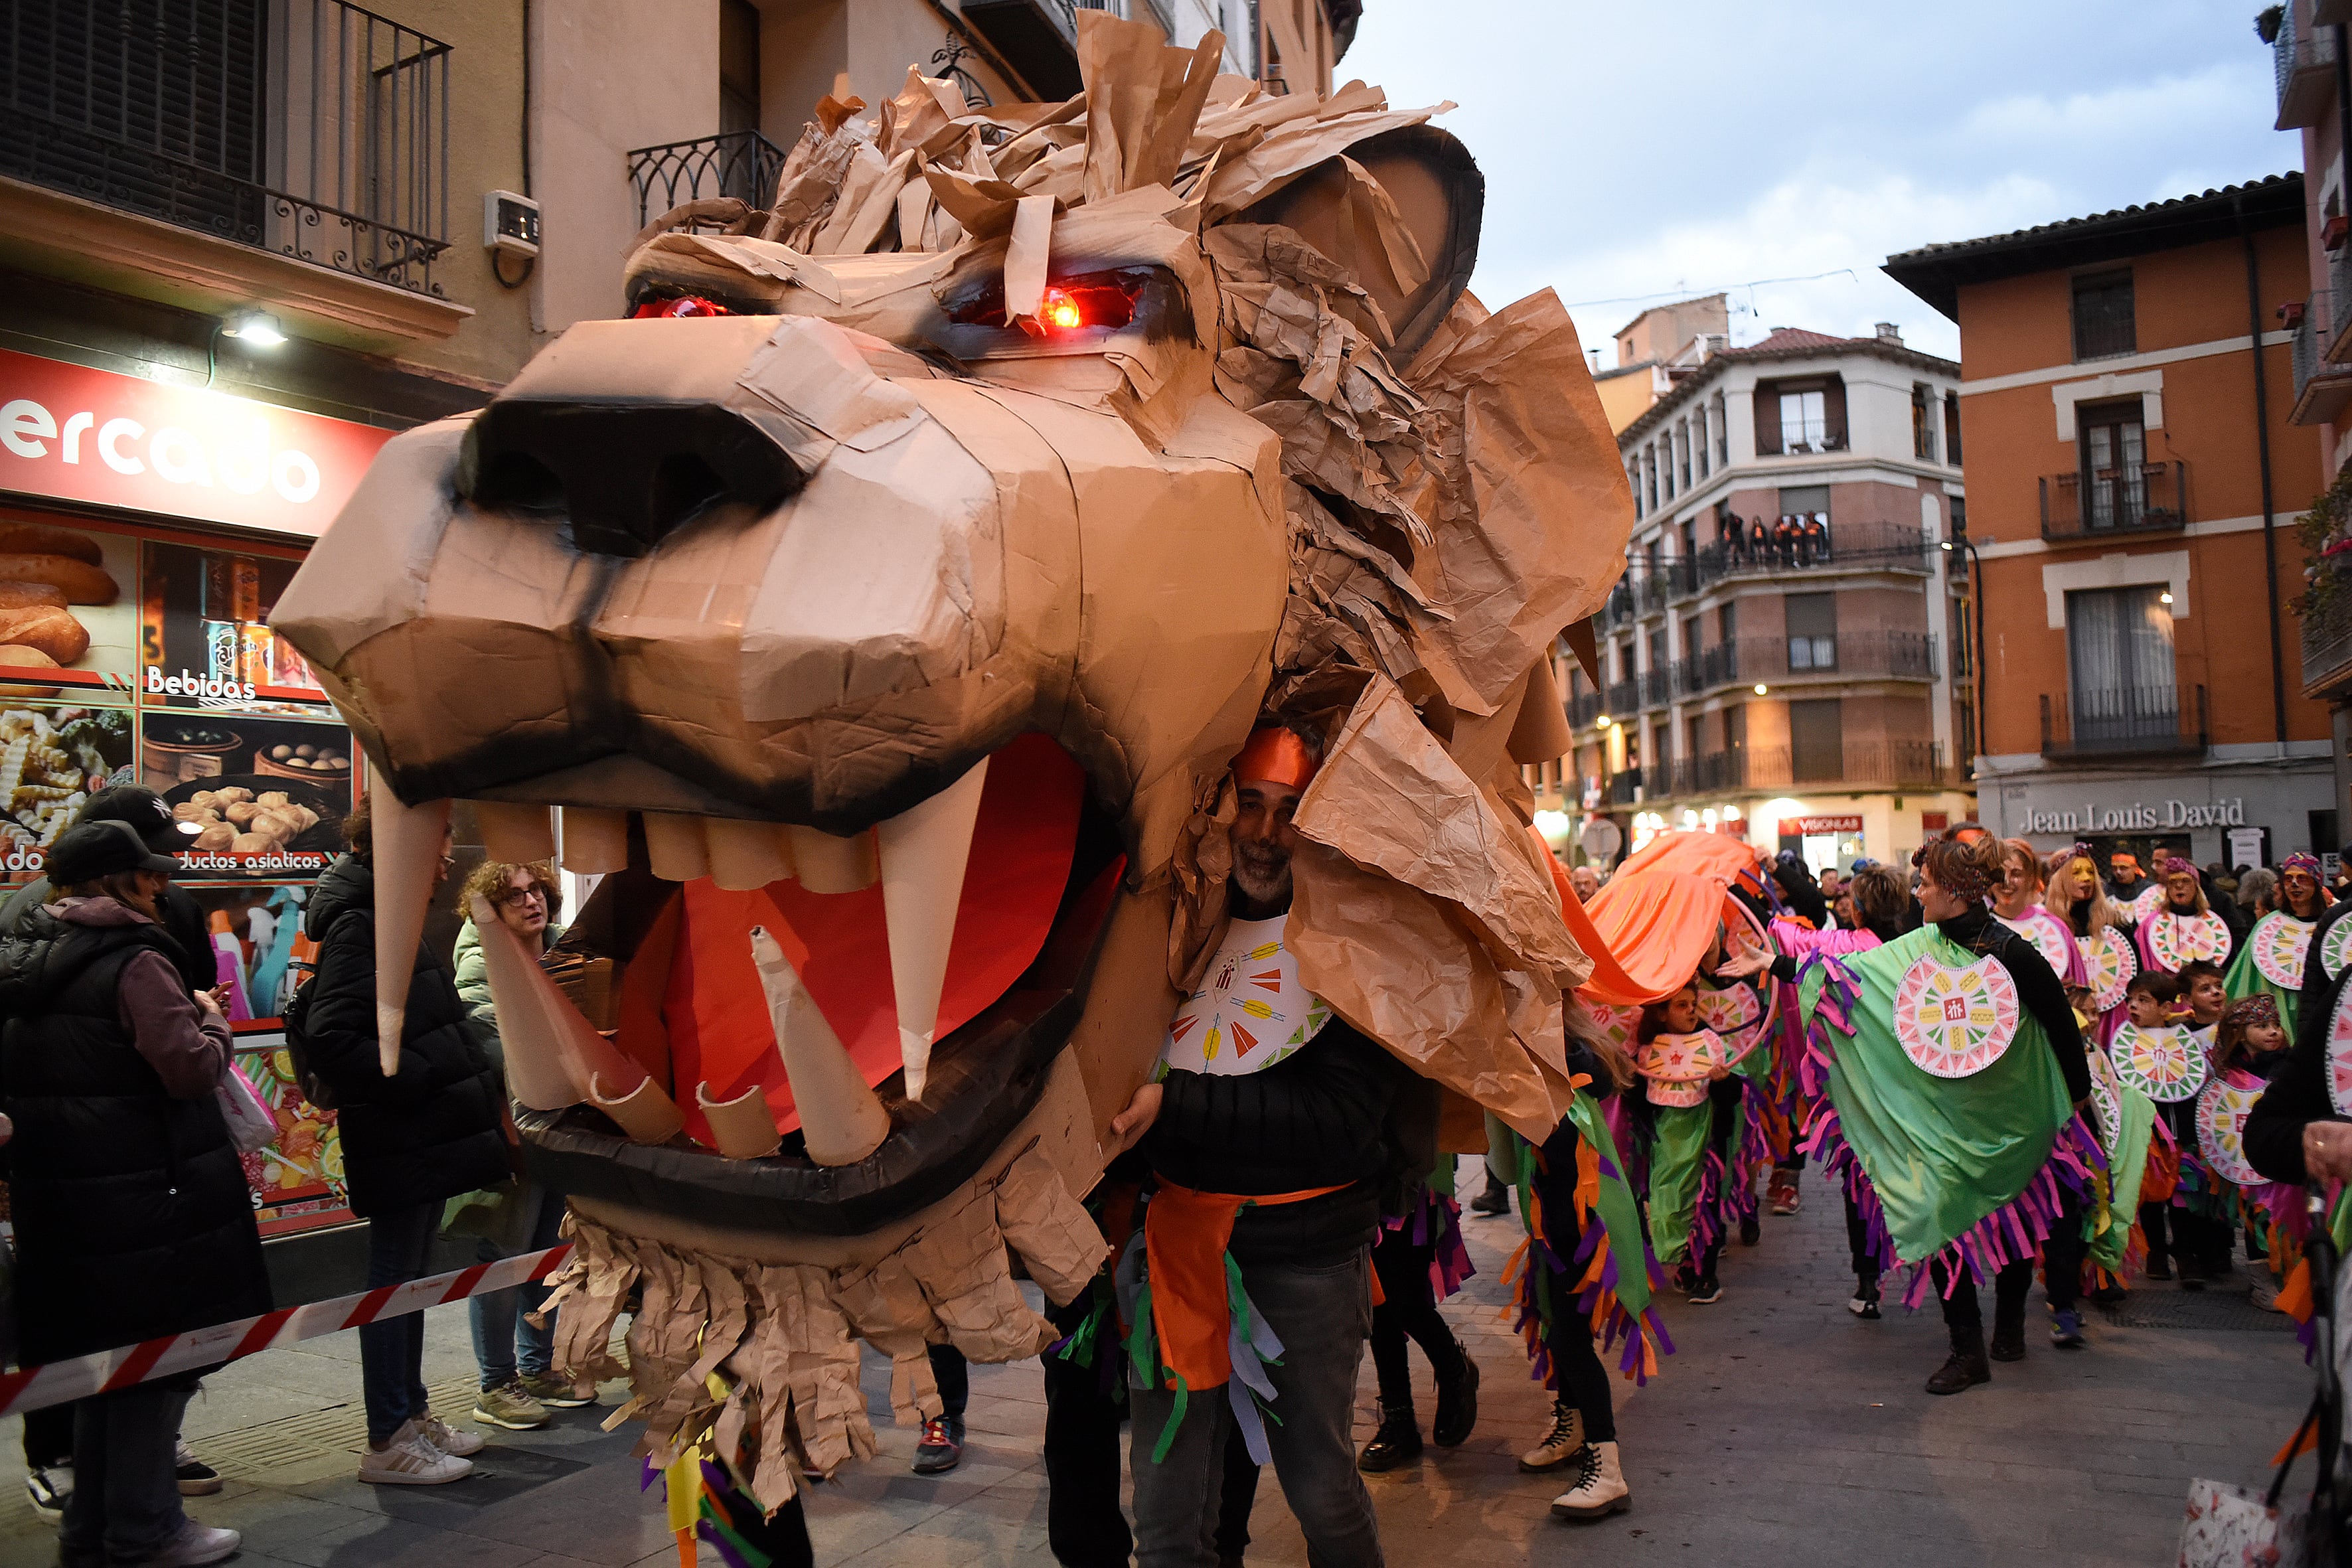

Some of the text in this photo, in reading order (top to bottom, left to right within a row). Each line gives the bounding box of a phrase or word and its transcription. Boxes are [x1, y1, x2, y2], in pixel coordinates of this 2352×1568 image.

[0, 399, 321, 504] ercado
[147, 665, 256, 700] Bebidas
[2020, 798, 2245, 835] Jean Louis David
[245, 852, 321, 869] asiaticos
